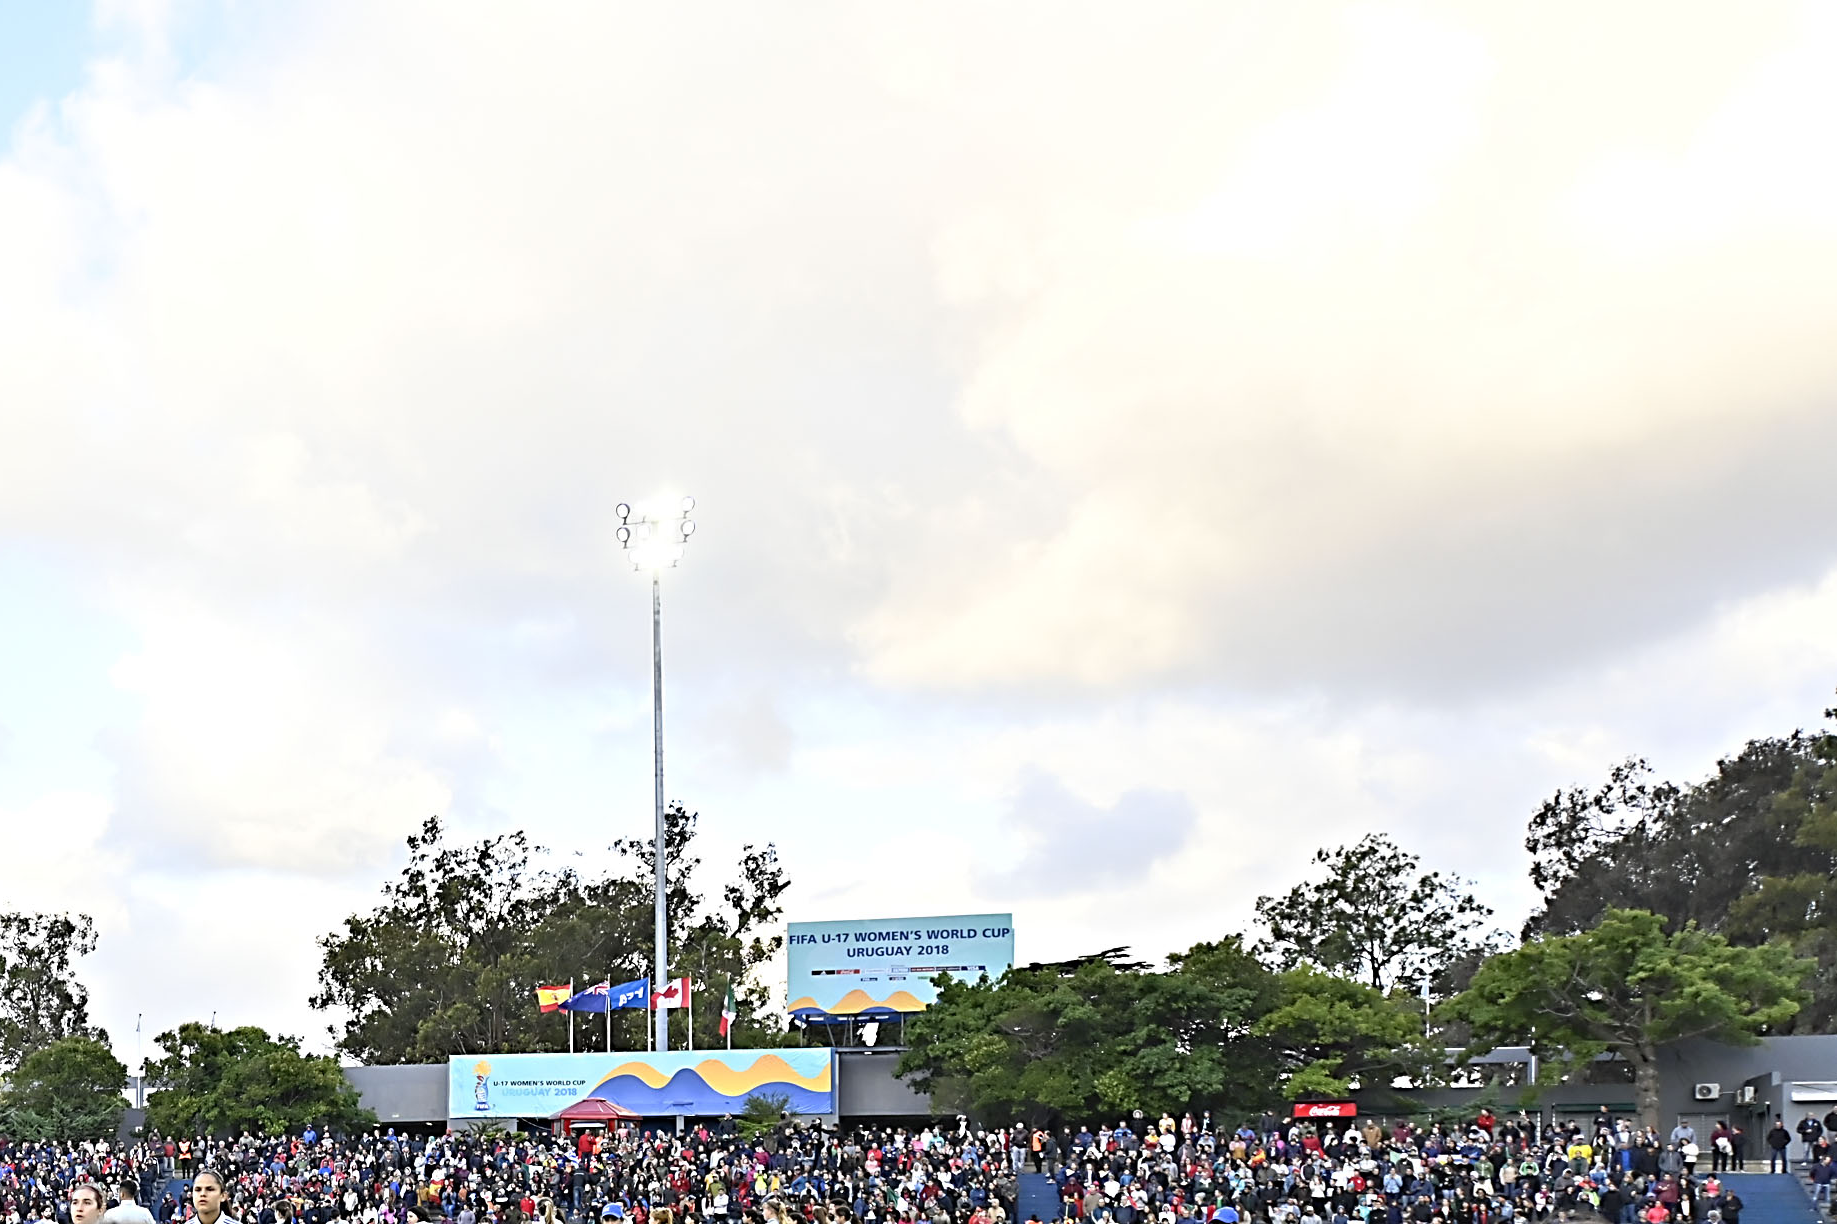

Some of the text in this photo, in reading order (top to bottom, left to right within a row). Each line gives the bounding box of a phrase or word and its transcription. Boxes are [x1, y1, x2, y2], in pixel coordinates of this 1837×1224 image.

[789, 928, 1010, 945] FIFA U-17 WOMEN'S WORLD CUP
[846, 944, 949, 958] URUGUAY 2018
[502, 1088, 578, 1097] URUGUAY 2018
